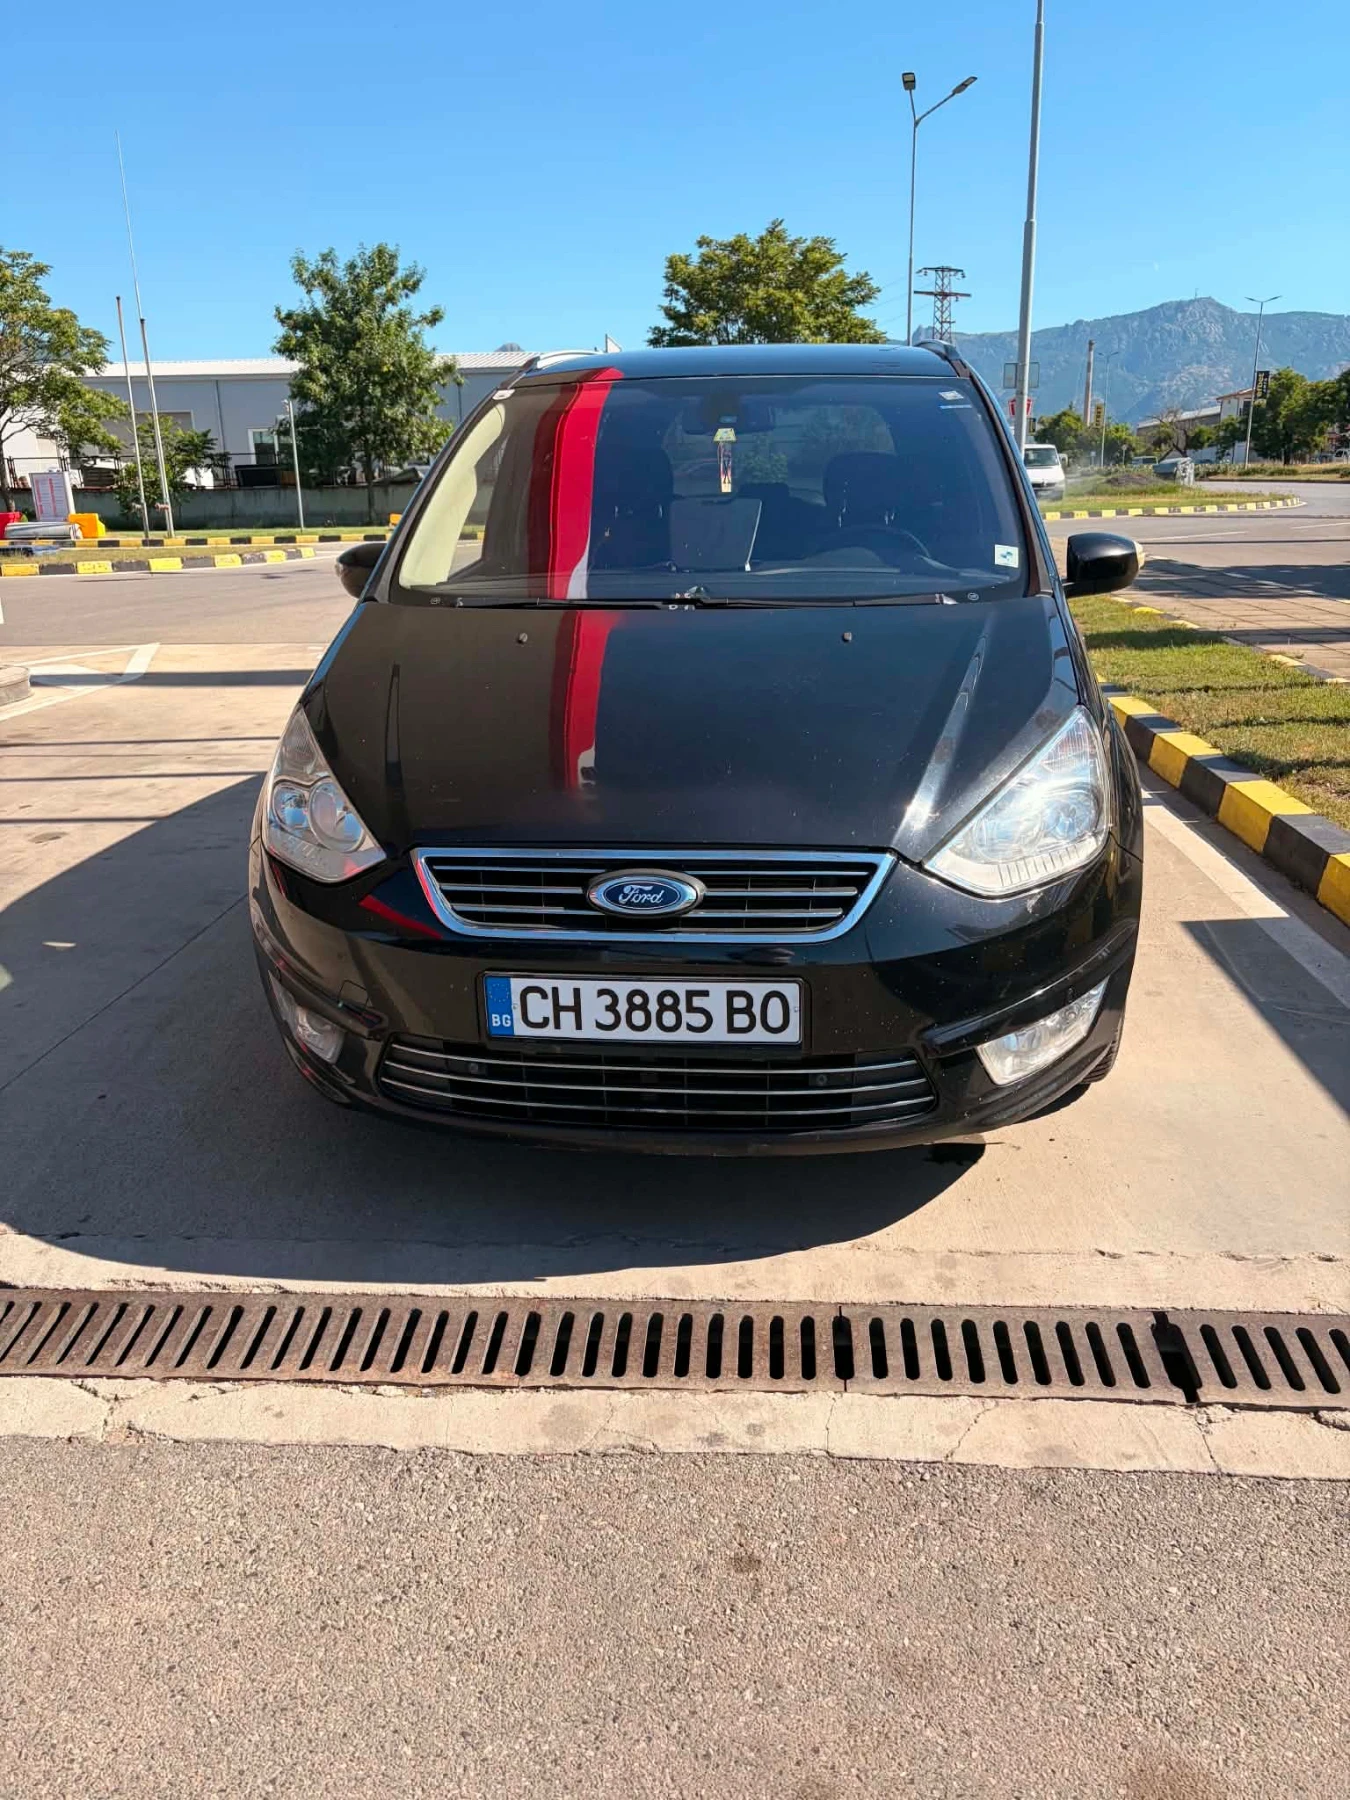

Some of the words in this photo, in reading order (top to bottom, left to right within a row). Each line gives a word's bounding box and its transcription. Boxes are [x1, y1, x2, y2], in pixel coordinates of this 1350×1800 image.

[619, 884, 665, 904] Ford
[520, 985, 582, 1030] CH
[595, 988, 713, 1033] 3885
[726, 990, 790, 1034] BO
[491, 1014, 512, 1027] BG
